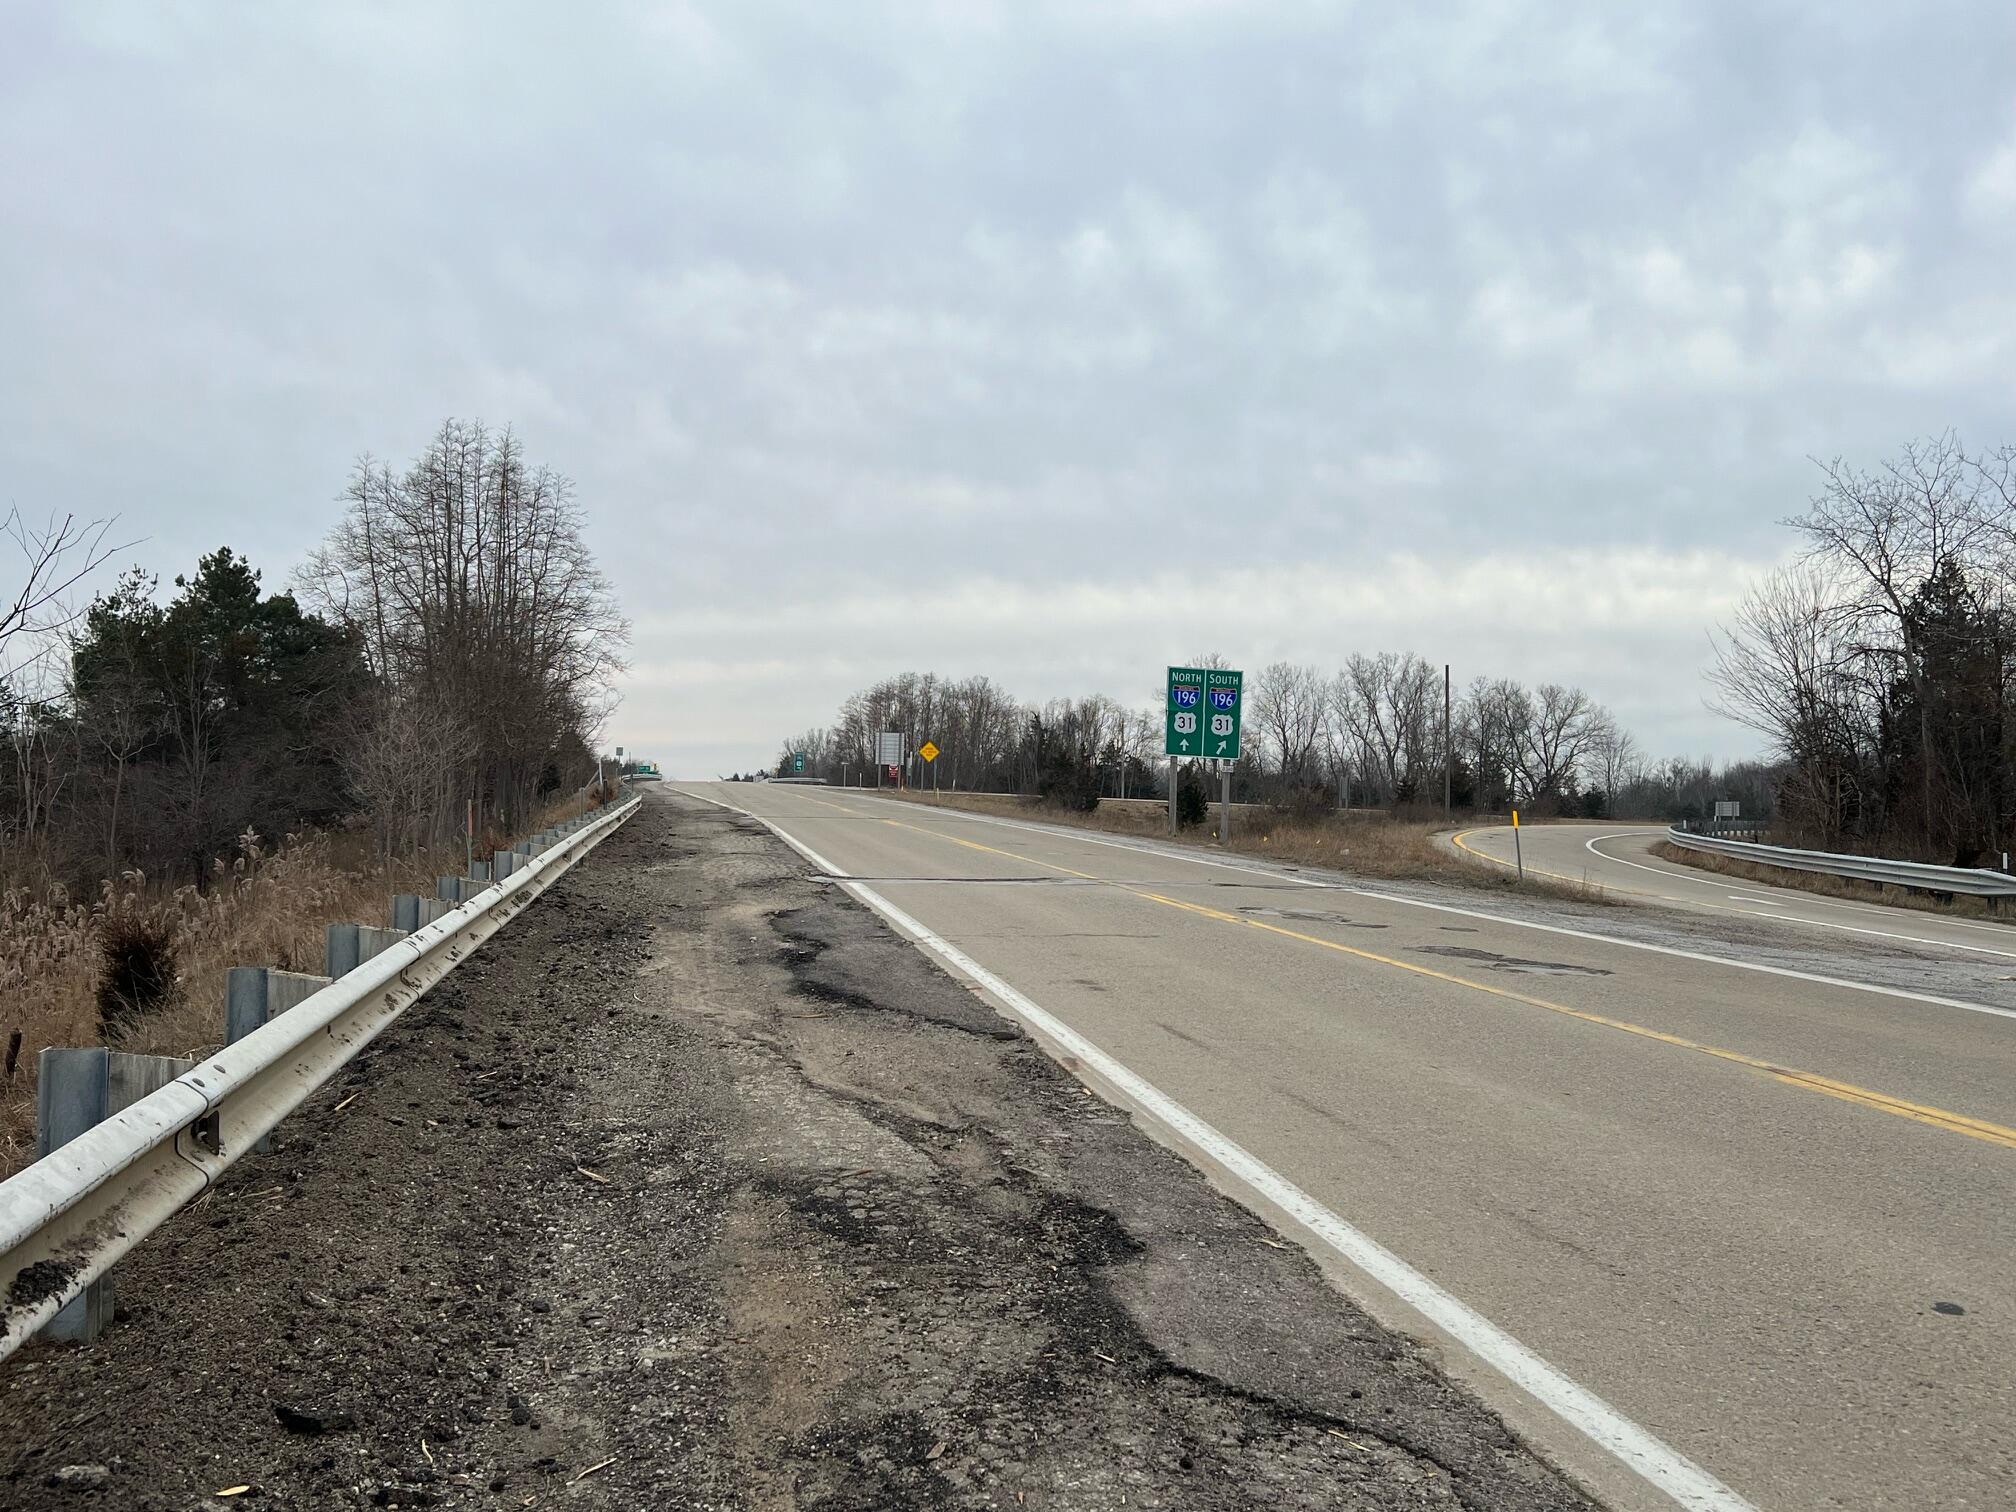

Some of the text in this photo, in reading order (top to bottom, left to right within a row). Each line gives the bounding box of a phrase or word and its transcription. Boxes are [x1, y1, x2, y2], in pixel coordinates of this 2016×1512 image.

[1172, 672, 1202, 683] NORTH
[1209, 674, 1239, 685] SOUTH
[1177, 691, 1196, 704] 196
[1214, 693, 1233, 706] 196
[1177, 716, 1192, 729] 31
[1214, 718, 1229, 731] 31
